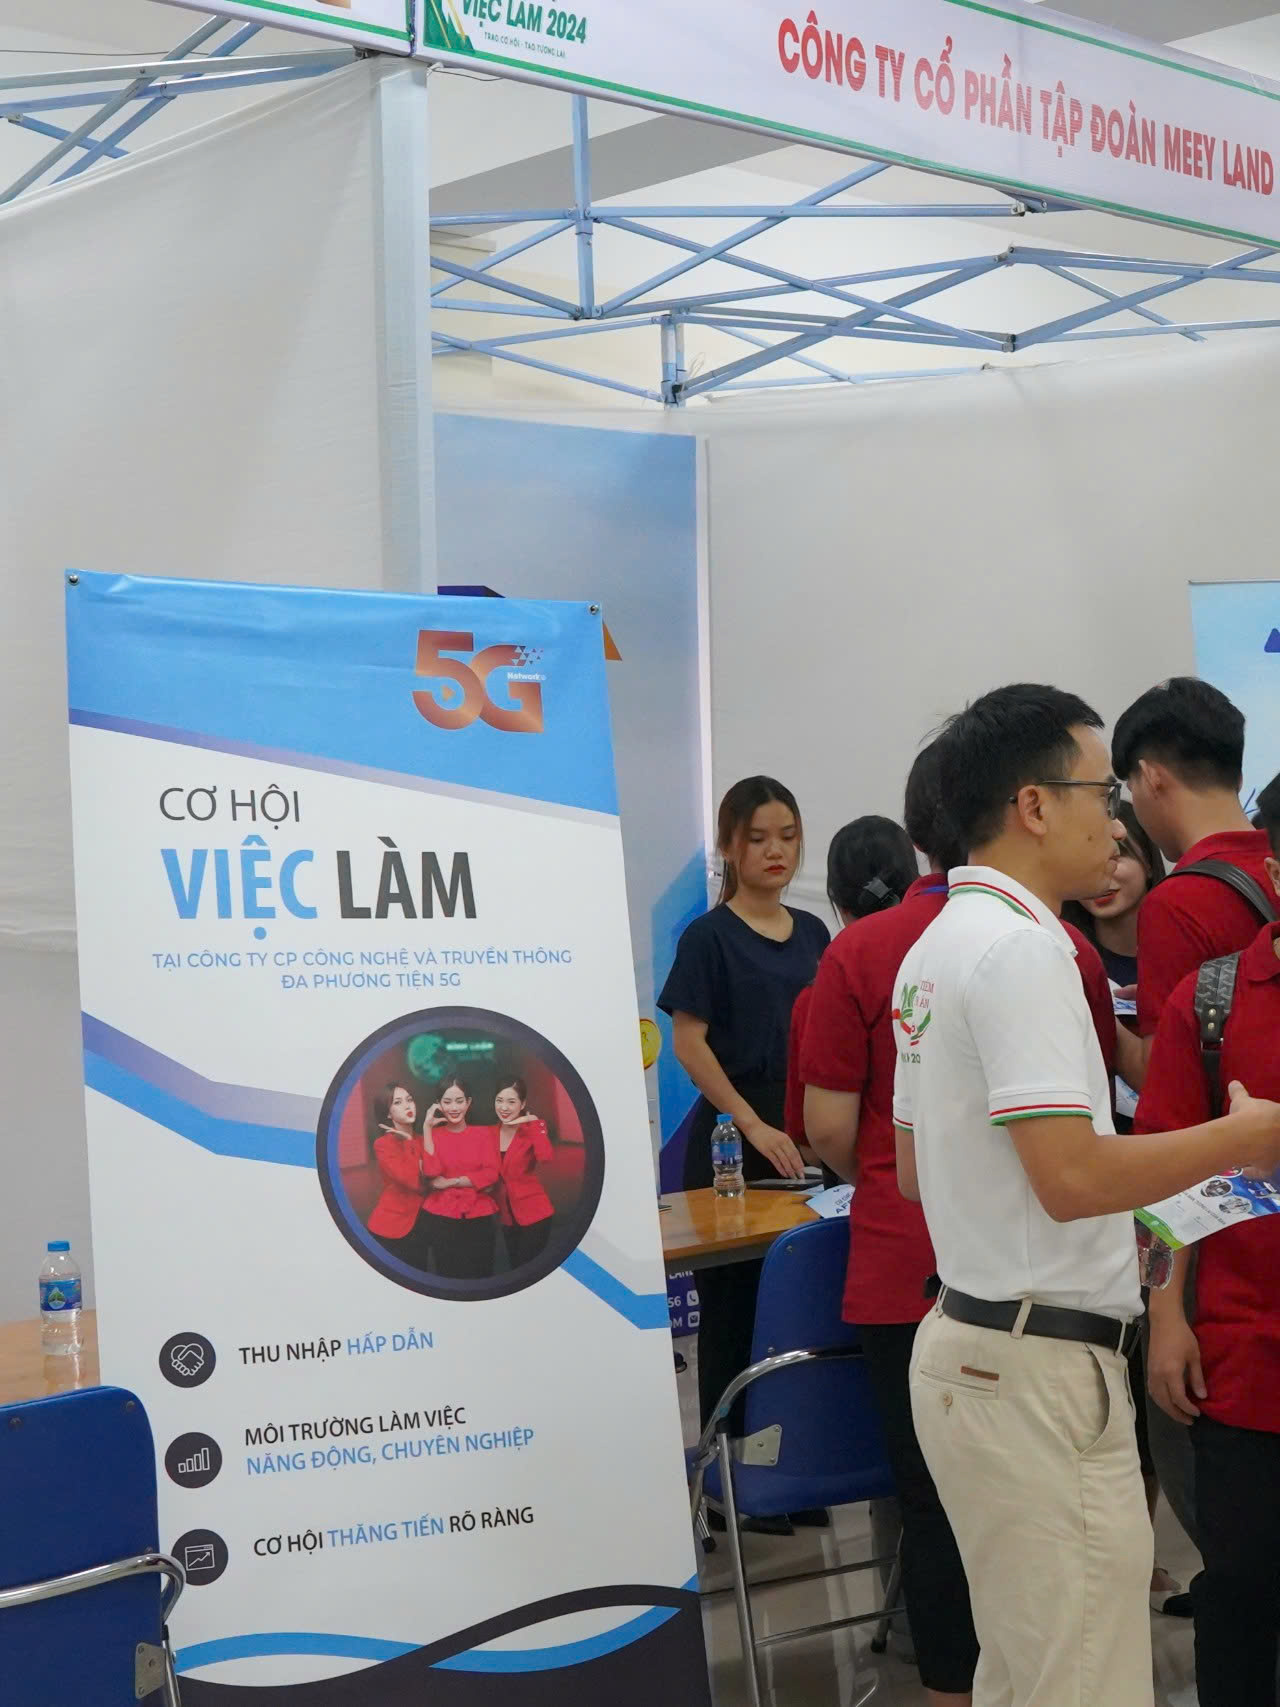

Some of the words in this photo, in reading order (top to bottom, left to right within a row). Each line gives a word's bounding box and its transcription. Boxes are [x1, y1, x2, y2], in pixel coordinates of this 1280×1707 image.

[546, 8, 587, 44] 2024
[778, 9, 866, 91] CÔNG
[875, 45, 905, 102] TY
[914, 35, 955, 115] CỔ
[964, 53, 1032, 135] PHẦN
[1040, 80, 1083, 158] TẬP
[1090, 100, 1156, 167] ĐOÀN
[1164, 124, 1216, 180] MEEY
[1223, 140, 1274, 196] LAND
[412, 630, 544, 733] 5G
[159, 785, 218, 822] CƠ
[230, 783, 300, 830] HỘI
[160, 834, 318, 940] VIỆC
[336, 836, 477, 919] LÀM
[152, 953, 181, 972] TẠI
[187, 950, 241, 967] CÔNG
[247, 952, 268, 966] TY
[274, 952, 297, 966] CP
[303, 948, 354, 966] CÔNG
[361, 948, 409, 969] NGHỆ
[414, 948, 437, 965] VÀ
[441, 946, 508, 964] TRUYỀN
[512, 947, 572, 964] THÔNG
[281, 974, 308, 988] ĐA
[314, 973, 391, 988] PHƯƠNG
[396, 970, 434, 990] TIỆN
[440, 973, 461, 987] 5G
[239, 1345, 280, 1365] THU
[286, 1337, 341, 1362] NHẬP
[347, 1331, 387, 1355] HẤP
[392, 1326, 434, 1351] DẪN
[245, 1423, 284, 1446] MÔI
[288, 1416, 374, 1441] TRƯỜNG
[379, 1410, 421, 1432] LÀM
[424, 1405, 467, 1429] VIỆC
[247, 1452, 306, 1475] NĂNG
[311, 1445, 376, 1471] ĐỘNG,
[381, 1434, 460, 1461] CHUYÊN
[465, 1426, 534, 1451] NGHIỆP
[254, 1535, 283, 1556] CƠ
[287, 1529, 323, 1555] HỘI
[327, 1522, 398, 1547] THĂNG
[401, 1513, 444, 1538] TIẾN
[449, 1511, 476, 1533] RÕ
[481, 1506, 535, 1529] RÀNG
